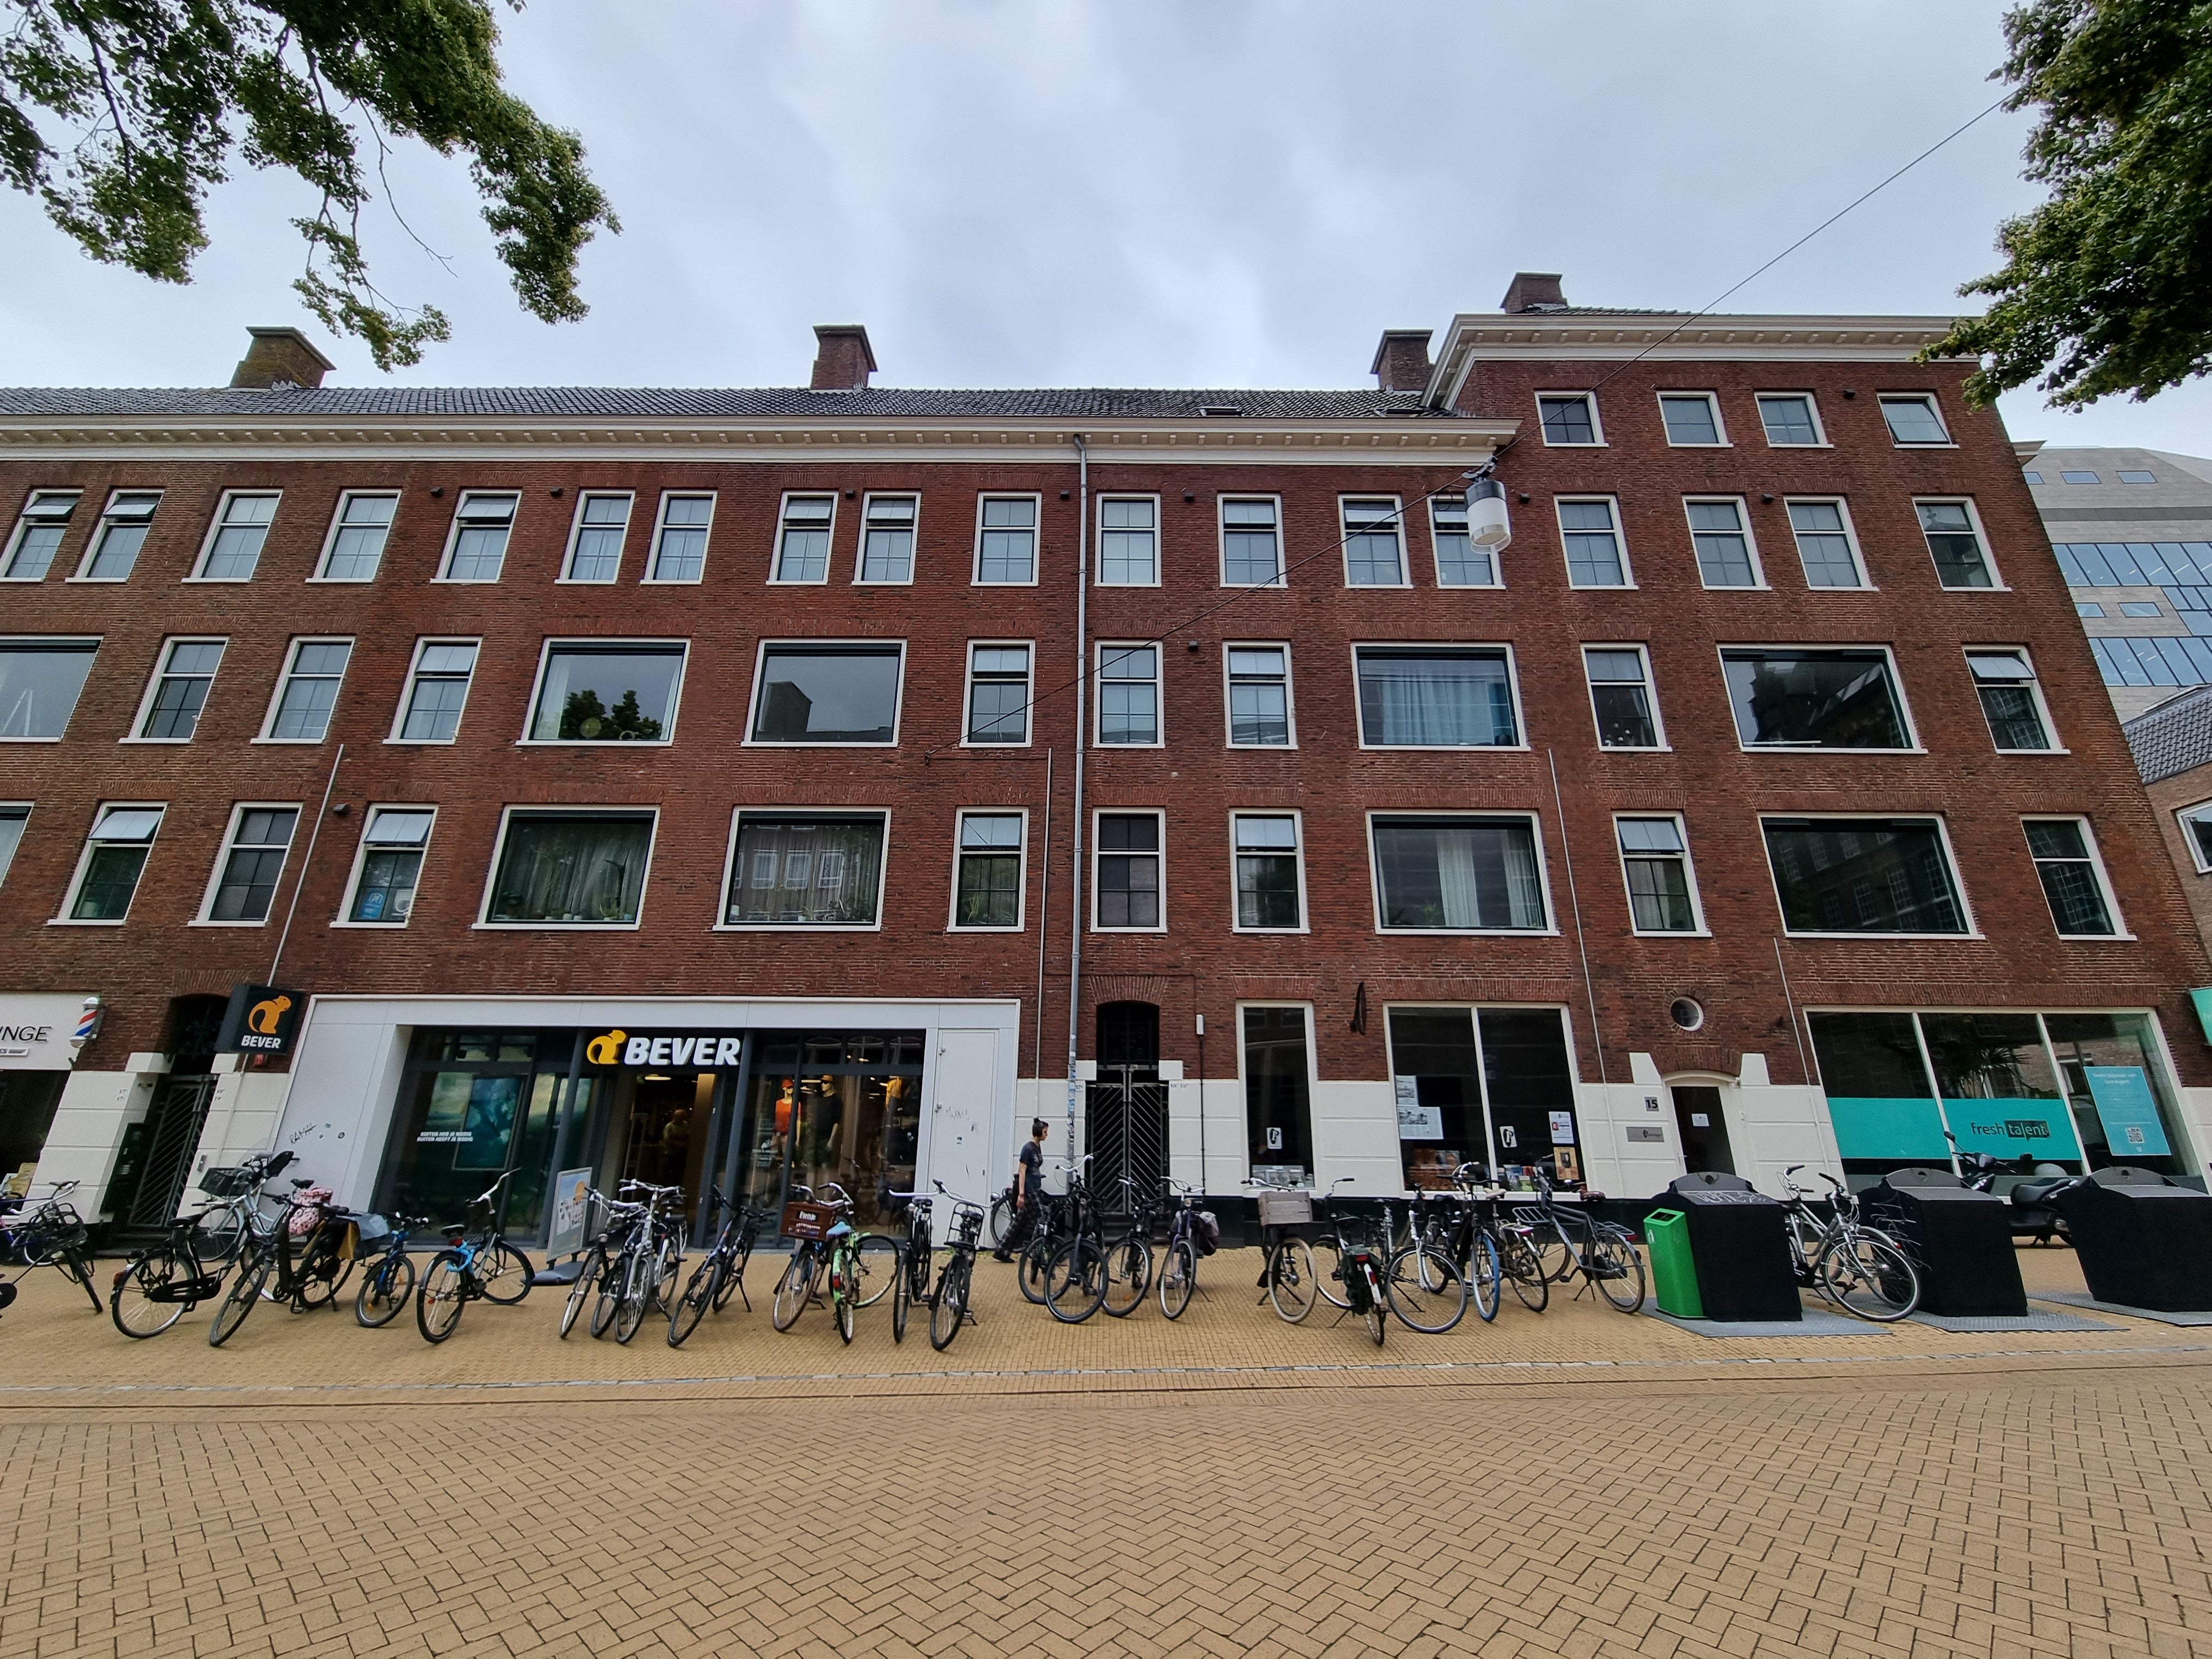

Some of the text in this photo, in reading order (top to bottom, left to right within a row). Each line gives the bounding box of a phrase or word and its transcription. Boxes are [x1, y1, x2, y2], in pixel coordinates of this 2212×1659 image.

[241, 1035, 281, 1049] BEVER
[624, 1037, 741, 1065] BEVER
[1646, 1099, 1658, 1108] 15
[1971, 1122, 2048, 1137] fresh talent
